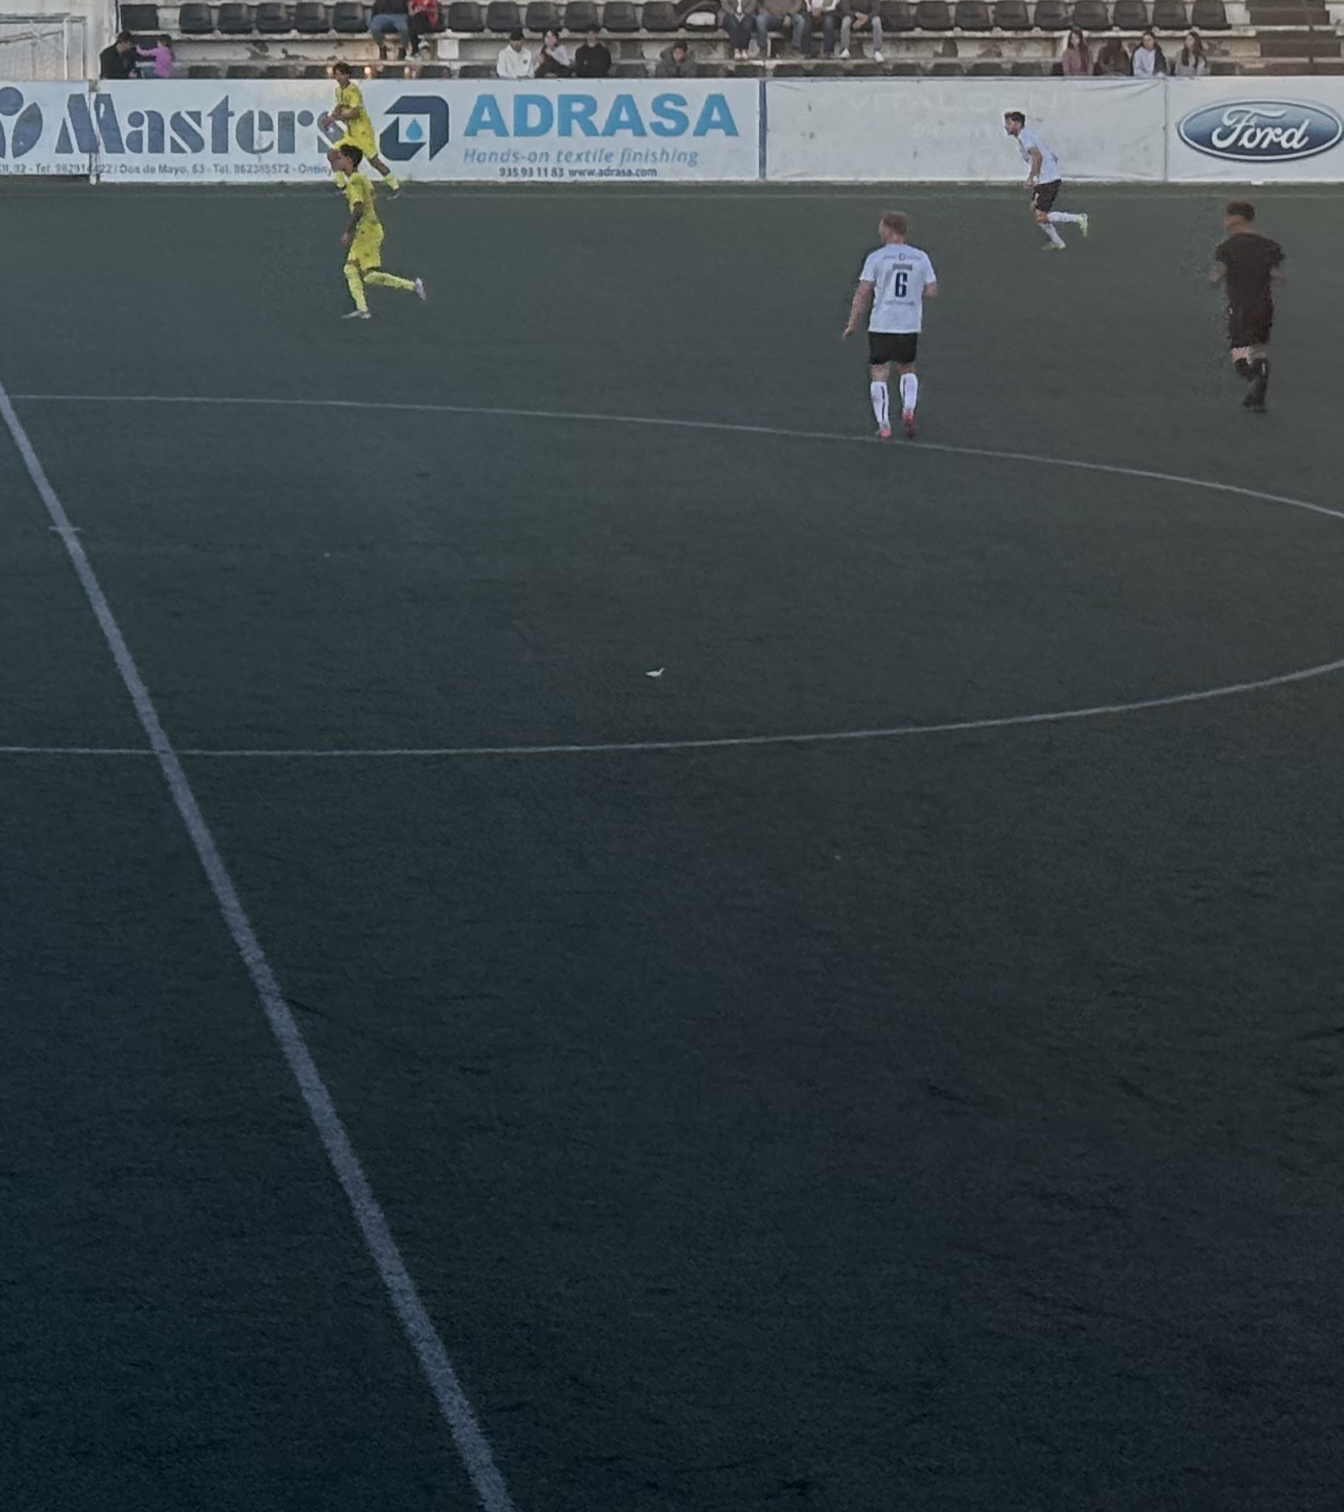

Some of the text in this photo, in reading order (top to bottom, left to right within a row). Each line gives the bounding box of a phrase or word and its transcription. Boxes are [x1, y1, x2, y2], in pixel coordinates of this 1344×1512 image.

[55, 93, 345, 154] Masters
[463, 93, 740, 137] ADRASA
[1213, 108, 1309, 150] Ford
[463, 147, 699, 166] Hands-on textile finishing
[521, 167, 533, 177] 93
[569, 166, 657, 177] www.adrasa.com
[894, 272, 908, 297] 6
